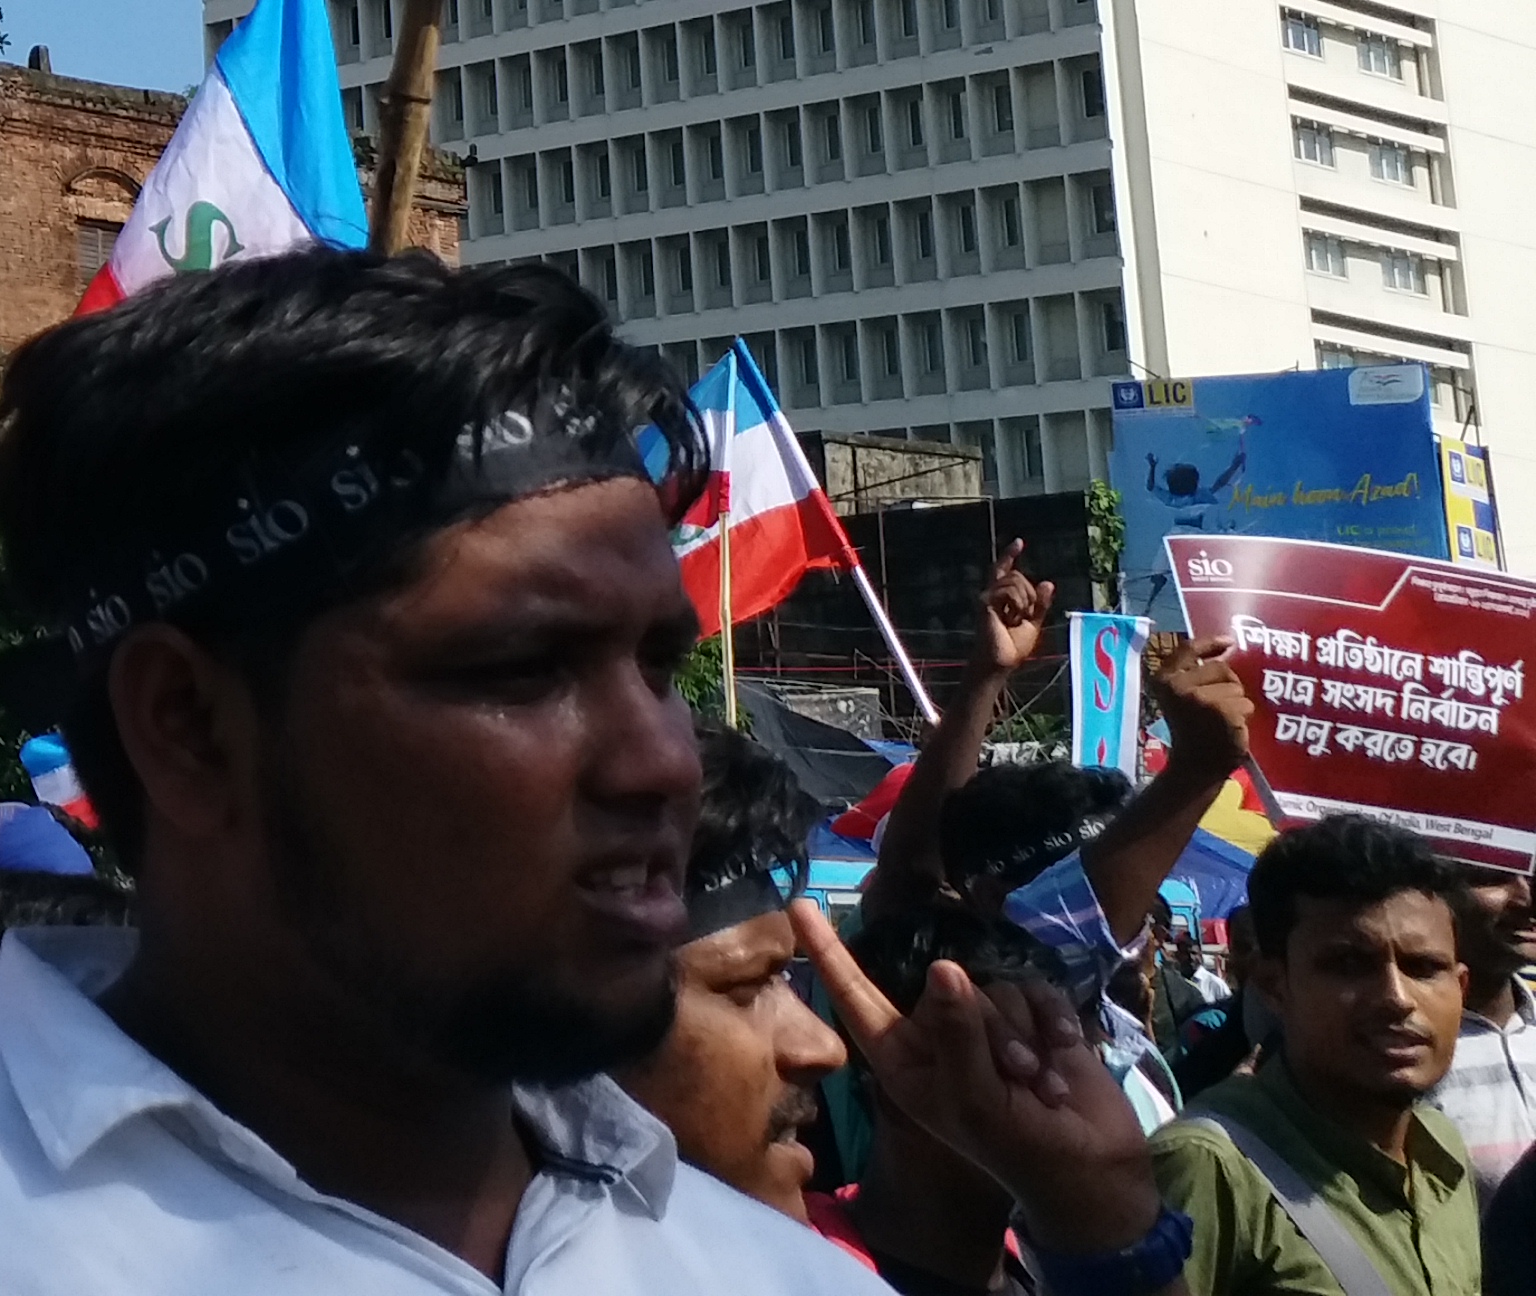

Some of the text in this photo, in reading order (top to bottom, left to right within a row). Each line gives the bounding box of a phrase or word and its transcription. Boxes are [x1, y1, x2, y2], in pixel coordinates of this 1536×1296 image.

[1148, 382, 1187, 405] LIC
[1228, 484, 1286, 515] Main
[1350, 473, 1420, 506] Azad!
[226, 497, 309, 565] sio
[1188, 550, 1232, 576] sio
[1231, 614, 1525, 706] শিক্ষা প্রতিষ্ঠানে শান্তিপূর্ণ
[1263, 668, 1500, 735] ছাত্র সংসদ নির্বাচন
[1275, 712, 1479, 771] চালু করতে হবে।
[1043, 830, 1073, 851] sio
[1078, 818, 1106, 842] sio
[1425, 818, 1452, 834] West
[1453, 821, 1494, 840] Bengal
